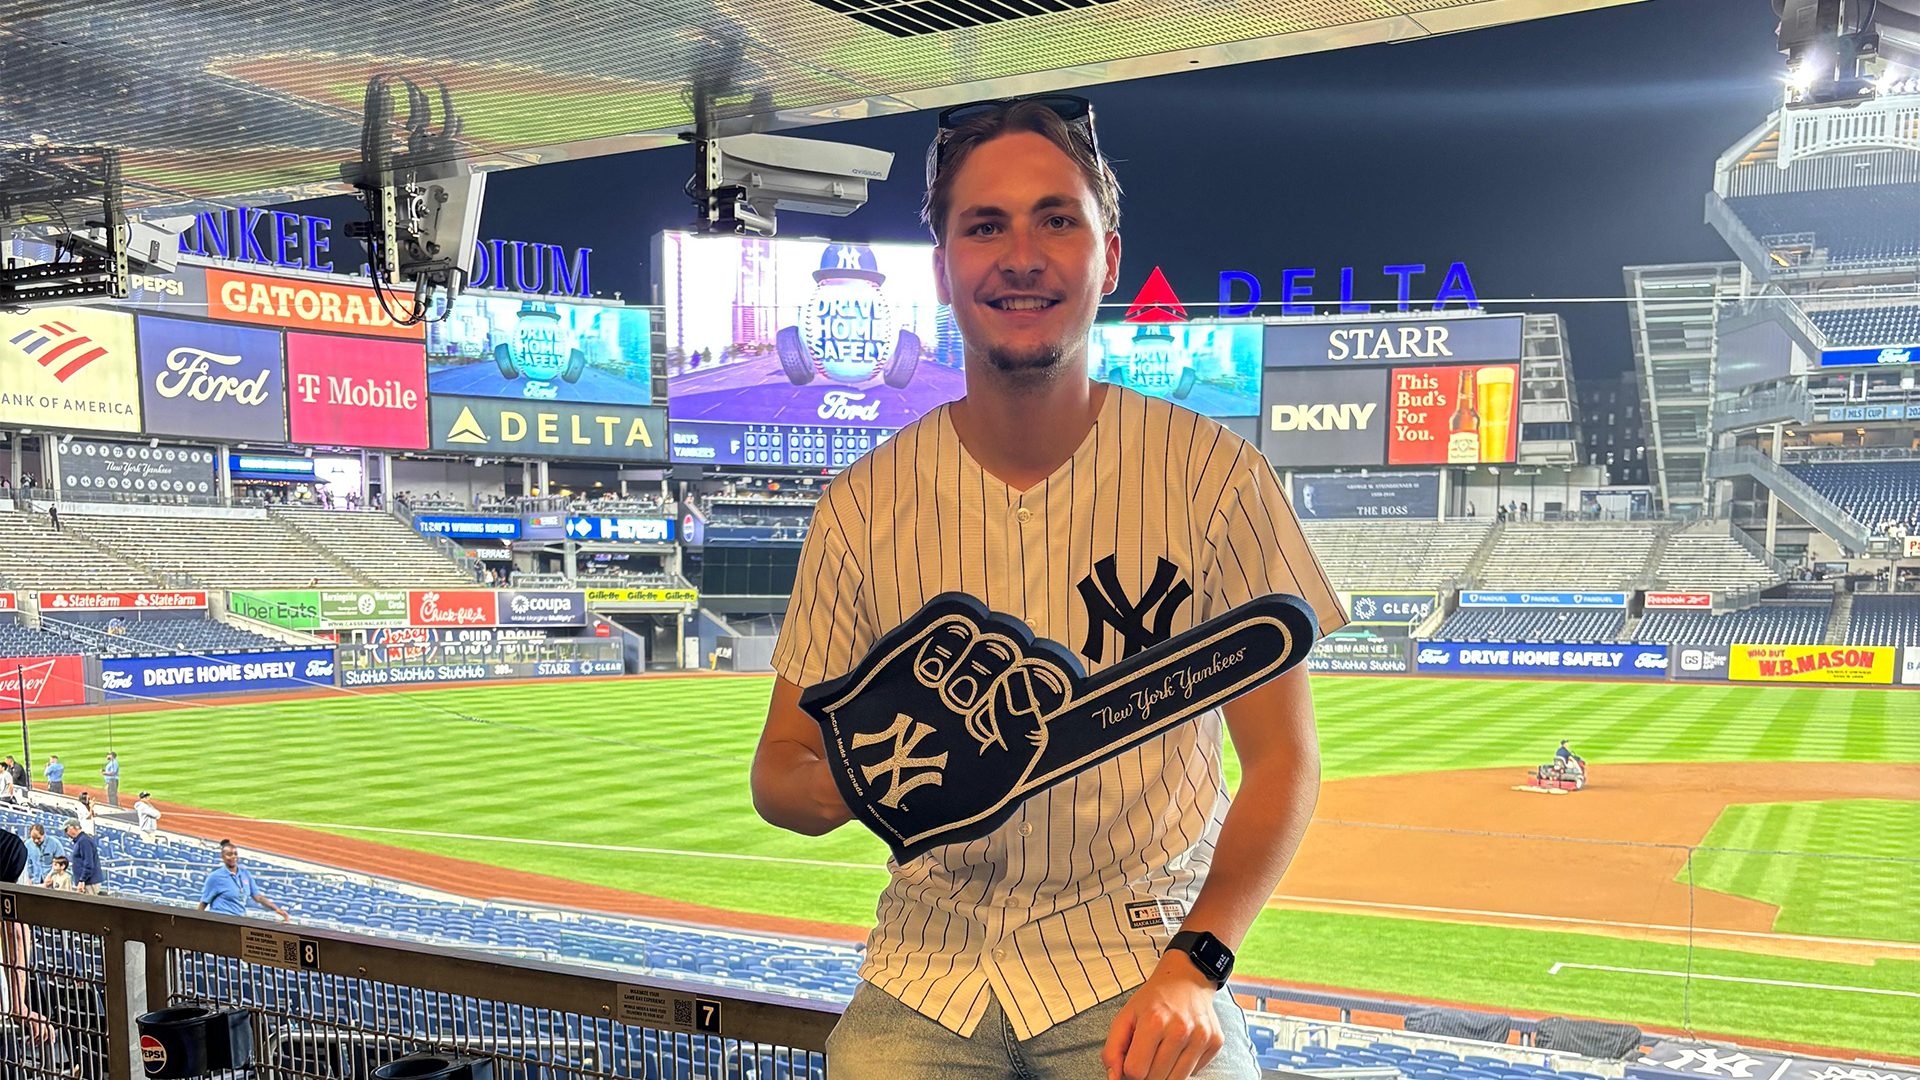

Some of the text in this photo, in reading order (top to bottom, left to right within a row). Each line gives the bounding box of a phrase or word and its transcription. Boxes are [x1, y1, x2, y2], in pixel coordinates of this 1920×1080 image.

[179, 206, 333, 273] NKEE
[131, 275, 184, 296] PEPSI
[1219, 261, 1479, 317] DELTA
[220, 280, 415, 329] GATORADE
[813, 340, 888, 362] SAFELY
[1328, 326, 1452, 361] STARR
[156, 346, 271, 406] Ford
[1397, 373, 1439, 390] This
[327, 377, 418, 410] Mobile
[1397, 390, 1447, 407] Bud's
[0, 392, 134, 416] ANK OF AMERICA
[817, 391, 880, 421] Ford
[1271, 403, 1377, 432] DKNY
[1396, 408, 1428, 424] For
[499, 411, 653, 447] DELTA
[1395, 425, 1435, 442] You.
[1356, 506, 1408, 516] THE BOSS
[235, 601, 317, 619] Uber Eats
[529, 597, 571, 613] coupa
[1077, 554, 1193, 664] NY
[1418, 649, 1450, 665] Ford
[1459, 650, 1624, 667] DRIVE HOME SAFELY
[1634, 653, 1669, 669] Ford
[1685, 655, 1699, 665] GS
[1747, 649, 1786, 659] WHO BUT
[144, 661, 296, 687] DRIVE HOME SAFELY
[305, 659, 333, 677] Ford
[346, 664, 486, 685] StubHub StubHub StubHub
[538, 663, 572, 675] STARR
[102, 671, 133, 690] Ford
[1092, 651, 1244, 729] New York Yankees
[851, 713, 948, 809] NY
[847, 768, 863, 796] Canada
[4, 898, 11, 914] 9
[305, 945, 314, 963] 8
[703, 1006, 714, 1026] 7
[142, 1050, 164, 1059] EPSI
